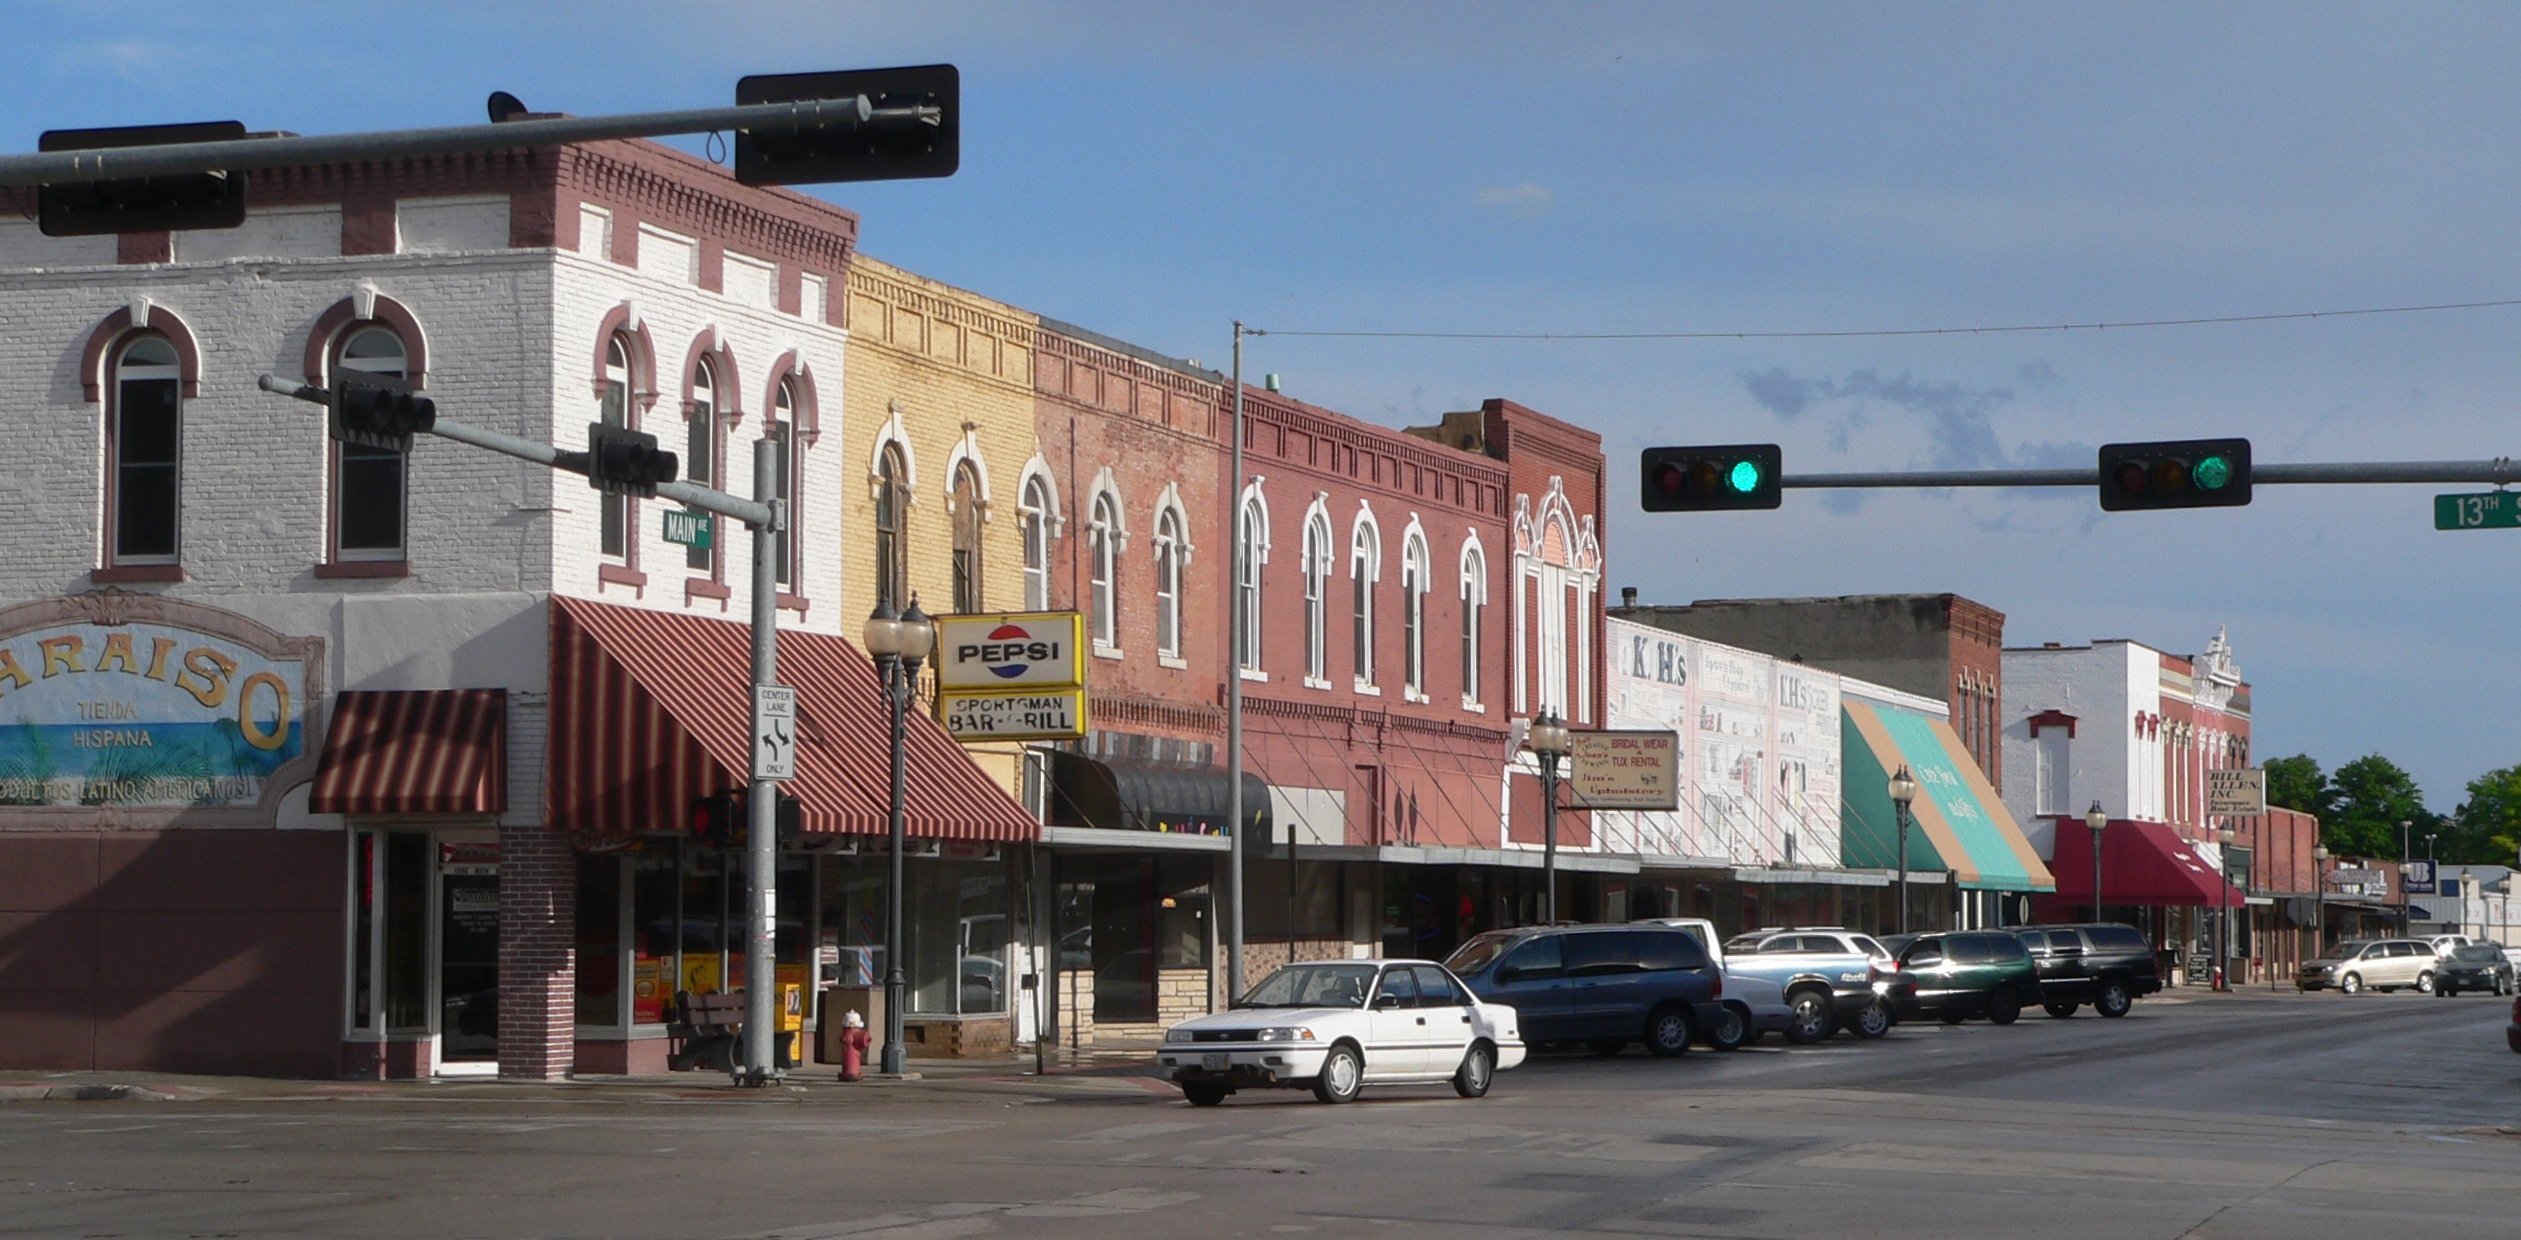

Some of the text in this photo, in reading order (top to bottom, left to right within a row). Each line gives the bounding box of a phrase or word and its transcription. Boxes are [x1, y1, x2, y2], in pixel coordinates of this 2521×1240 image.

[2456, 497, 2499, 526] 13TH
[667, 513, 696, 544] MAIN
[958, 642, 1059, 663] PEPSI
[762, 690, 790, 701] CENTER
[78, 701, 138, 720] TIENDA
[766, 702, 787, 712] LANE
[956, 697, 1063, 712] SPORTSMAN
[73, 729, 152, 749] HISPANA
[1611, 738, 1668, 749] BRIDAL WEAR
[1611, 756, 1661, 767] TUX RENTAL
[766, 764, 785, 774] ONLY
[2209, 773, 2241, 781] BILL
[79, 780, 136, 800] LATINO
[143, 779, 246, 800] AMERICANOS
[2210, 790, 2237, 798] INC.
